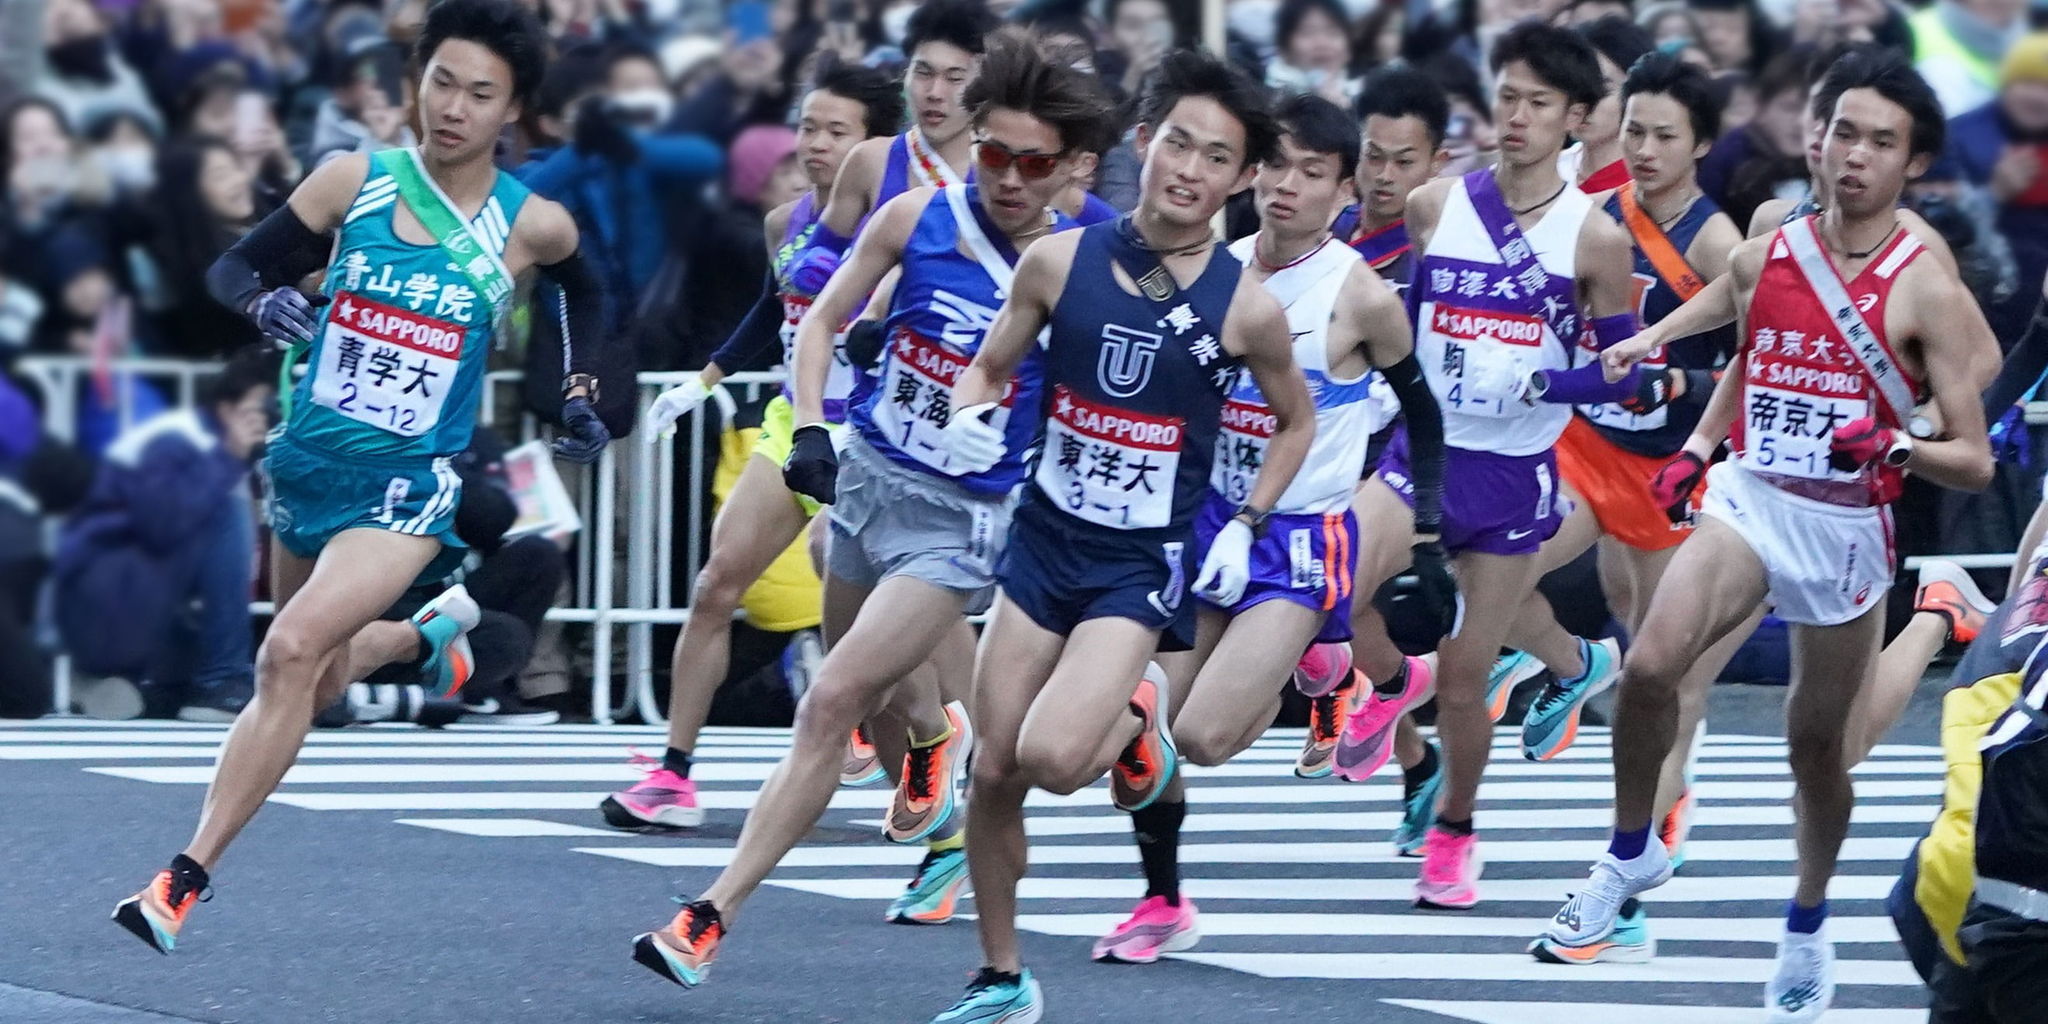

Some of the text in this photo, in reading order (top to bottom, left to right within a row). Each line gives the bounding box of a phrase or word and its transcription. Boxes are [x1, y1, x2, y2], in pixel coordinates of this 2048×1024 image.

[345, 250, 477, 322] 青山学院
[357, 307, 461, 353] SAPPORO
[1449, 314, 1541, 342] SAPPORO
[336, 335, 440, 398] 青学大
[1442, 342, 1466, 378] 駒
[1766, 362, 1862, 394] SAPPORO
[338, 382, 417, 431] 2-12
[893, 369, 952, 430] 東海
[1220, 405, 1278, 434] SAPPO
[1750, 392, 1849, 440] 帝京大
[1073, 407, 1180, 446] SAPPORO
[1057, 432, 1161, 495] 東洋大
[1066, 481, 1130, 524] 3-1
